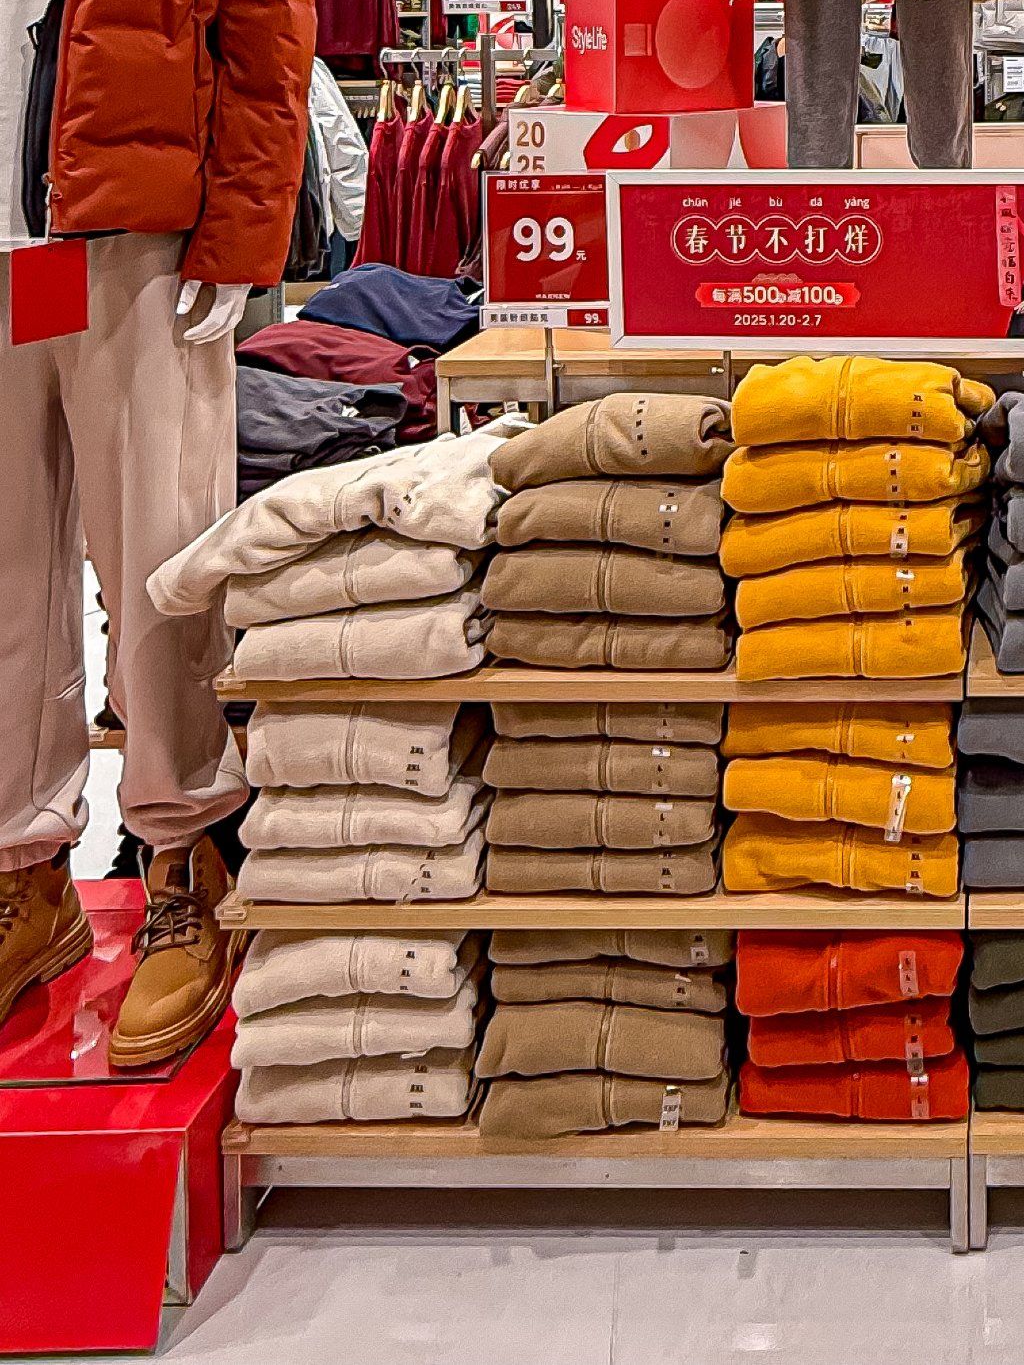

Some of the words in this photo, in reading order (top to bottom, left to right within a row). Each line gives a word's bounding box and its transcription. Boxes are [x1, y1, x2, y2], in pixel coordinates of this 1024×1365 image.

[516, 121, 545, 148] 20
[685, 225, 869, 254] 春节不打烊
